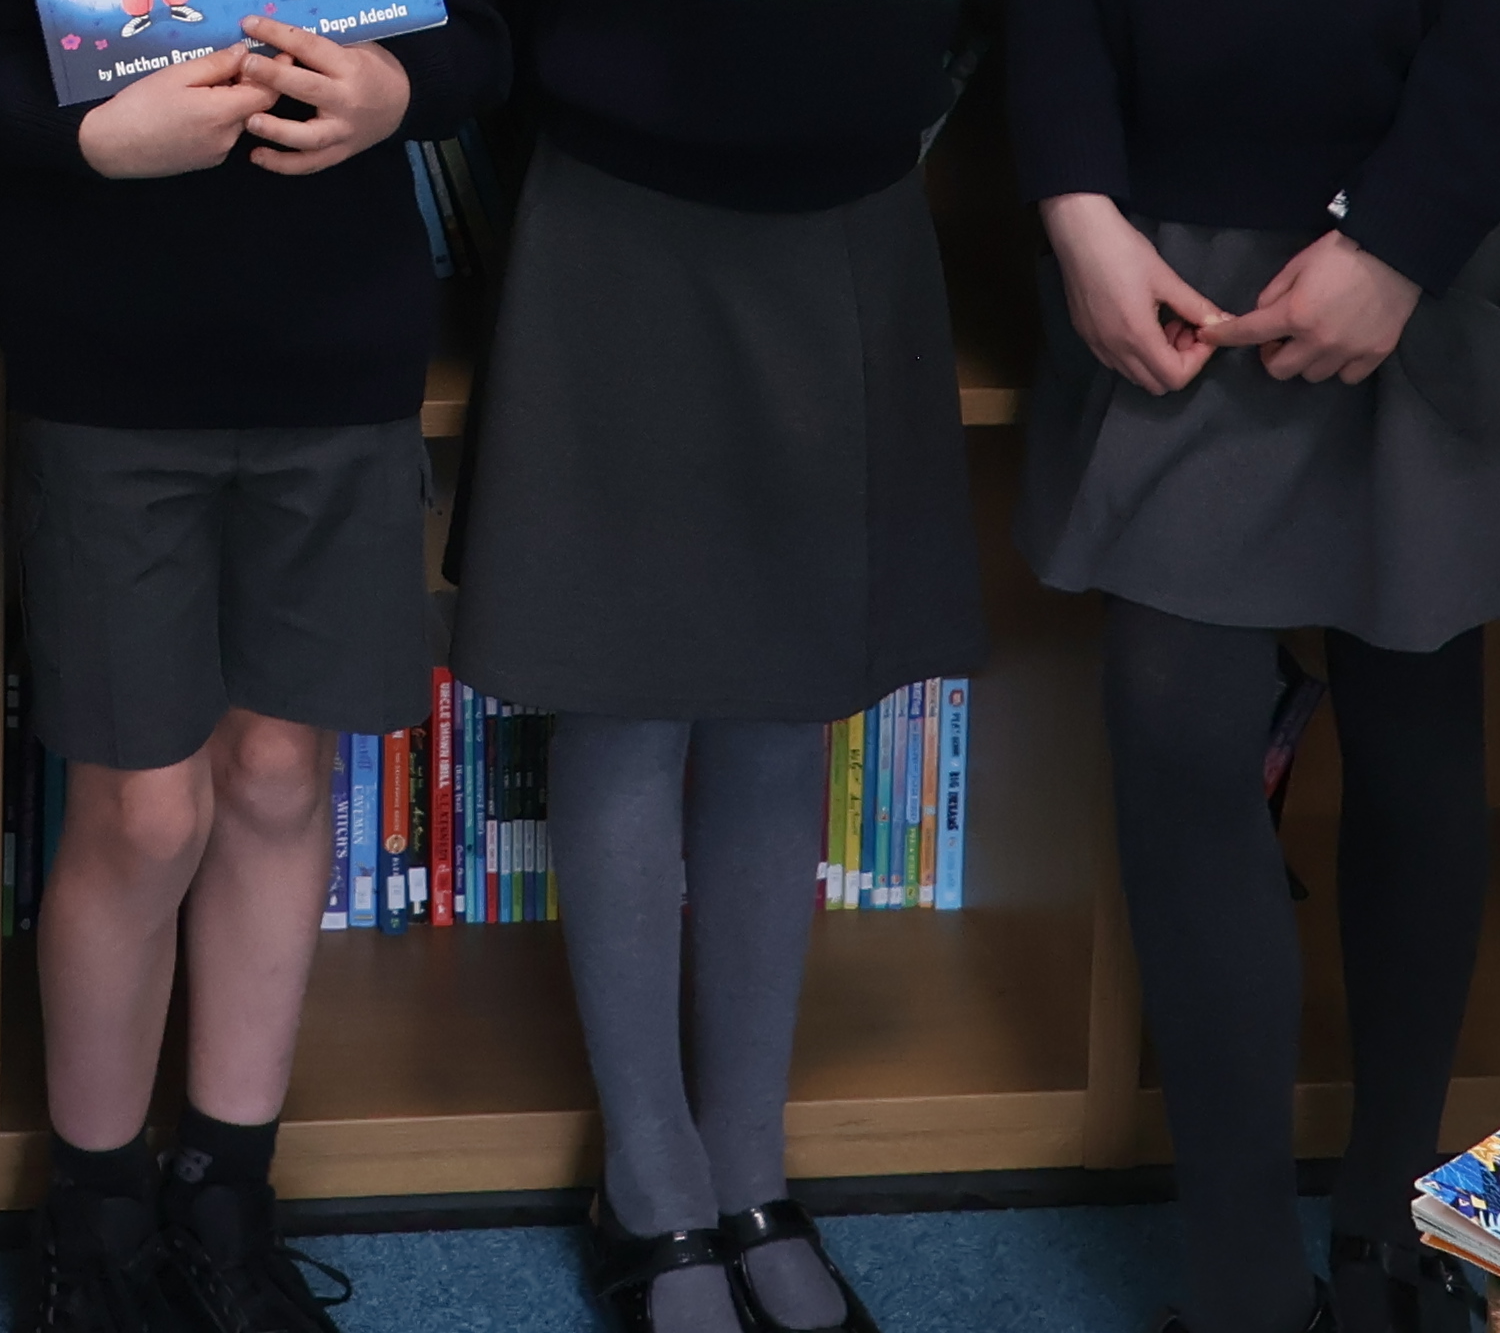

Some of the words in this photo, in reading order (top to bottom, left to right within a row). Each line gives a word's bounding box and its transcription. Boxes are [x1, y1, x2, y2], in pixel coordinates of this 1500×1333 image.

[319, 14, 357, 35] Dapo
[359, 3, 407, 26] Adeola
[98, 68, 112, 82] by
[114, 54, 169, 80] Nathan
[439, 682, 451, 719] UNCLE
[353, 785, 364, 845] CAVEMAN
